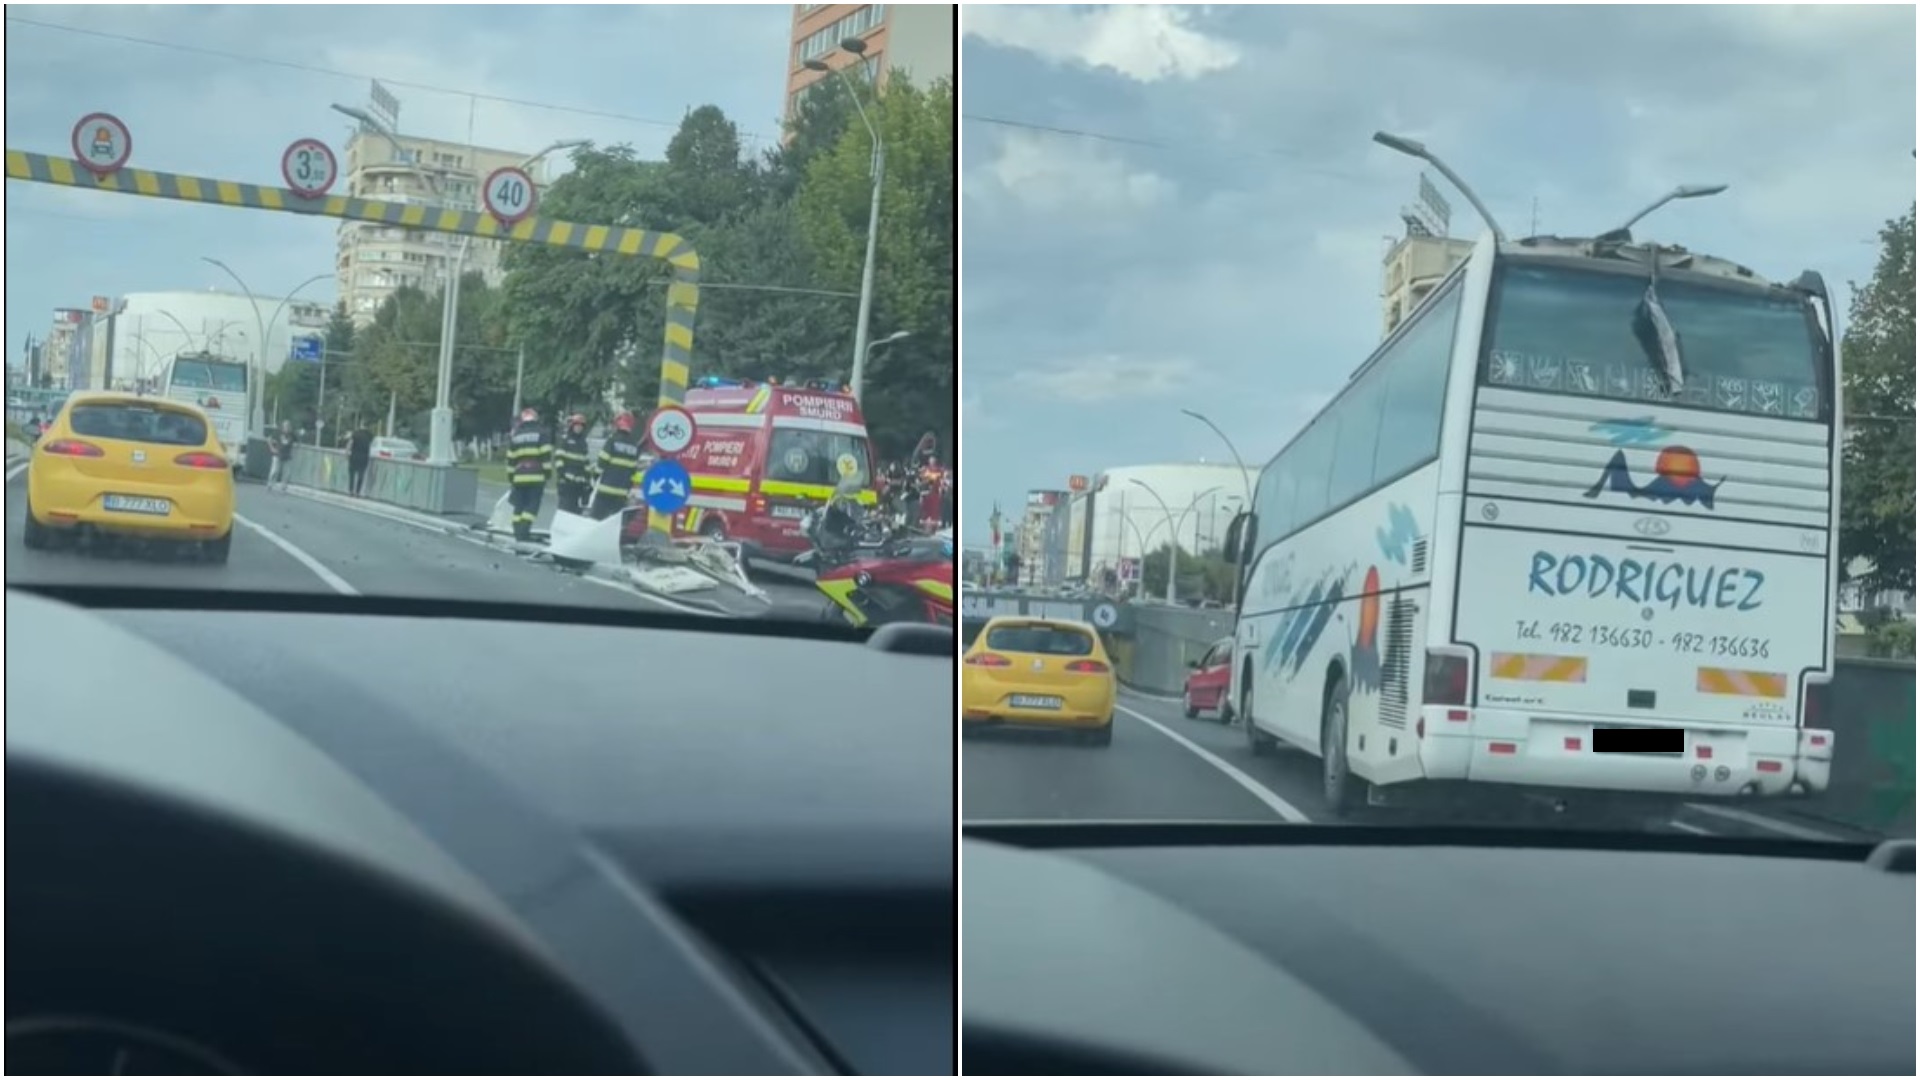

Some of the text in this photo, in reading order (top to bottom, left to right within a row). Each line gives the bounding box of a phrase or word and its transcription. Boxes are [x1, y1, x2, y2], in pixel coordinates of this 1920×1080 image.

[496, 179, 523, 207] 40
[1528, 550, 1765, 612] RODRIGUEZ
[1515, 619, 1542, 640] Tel.
[1549, 622, 1584, 645] 982
[1588, 625, 1654, 650] 136630
[1671, 631, 1705, 654] 982
[1709, 635, 1771, 660] 136636
